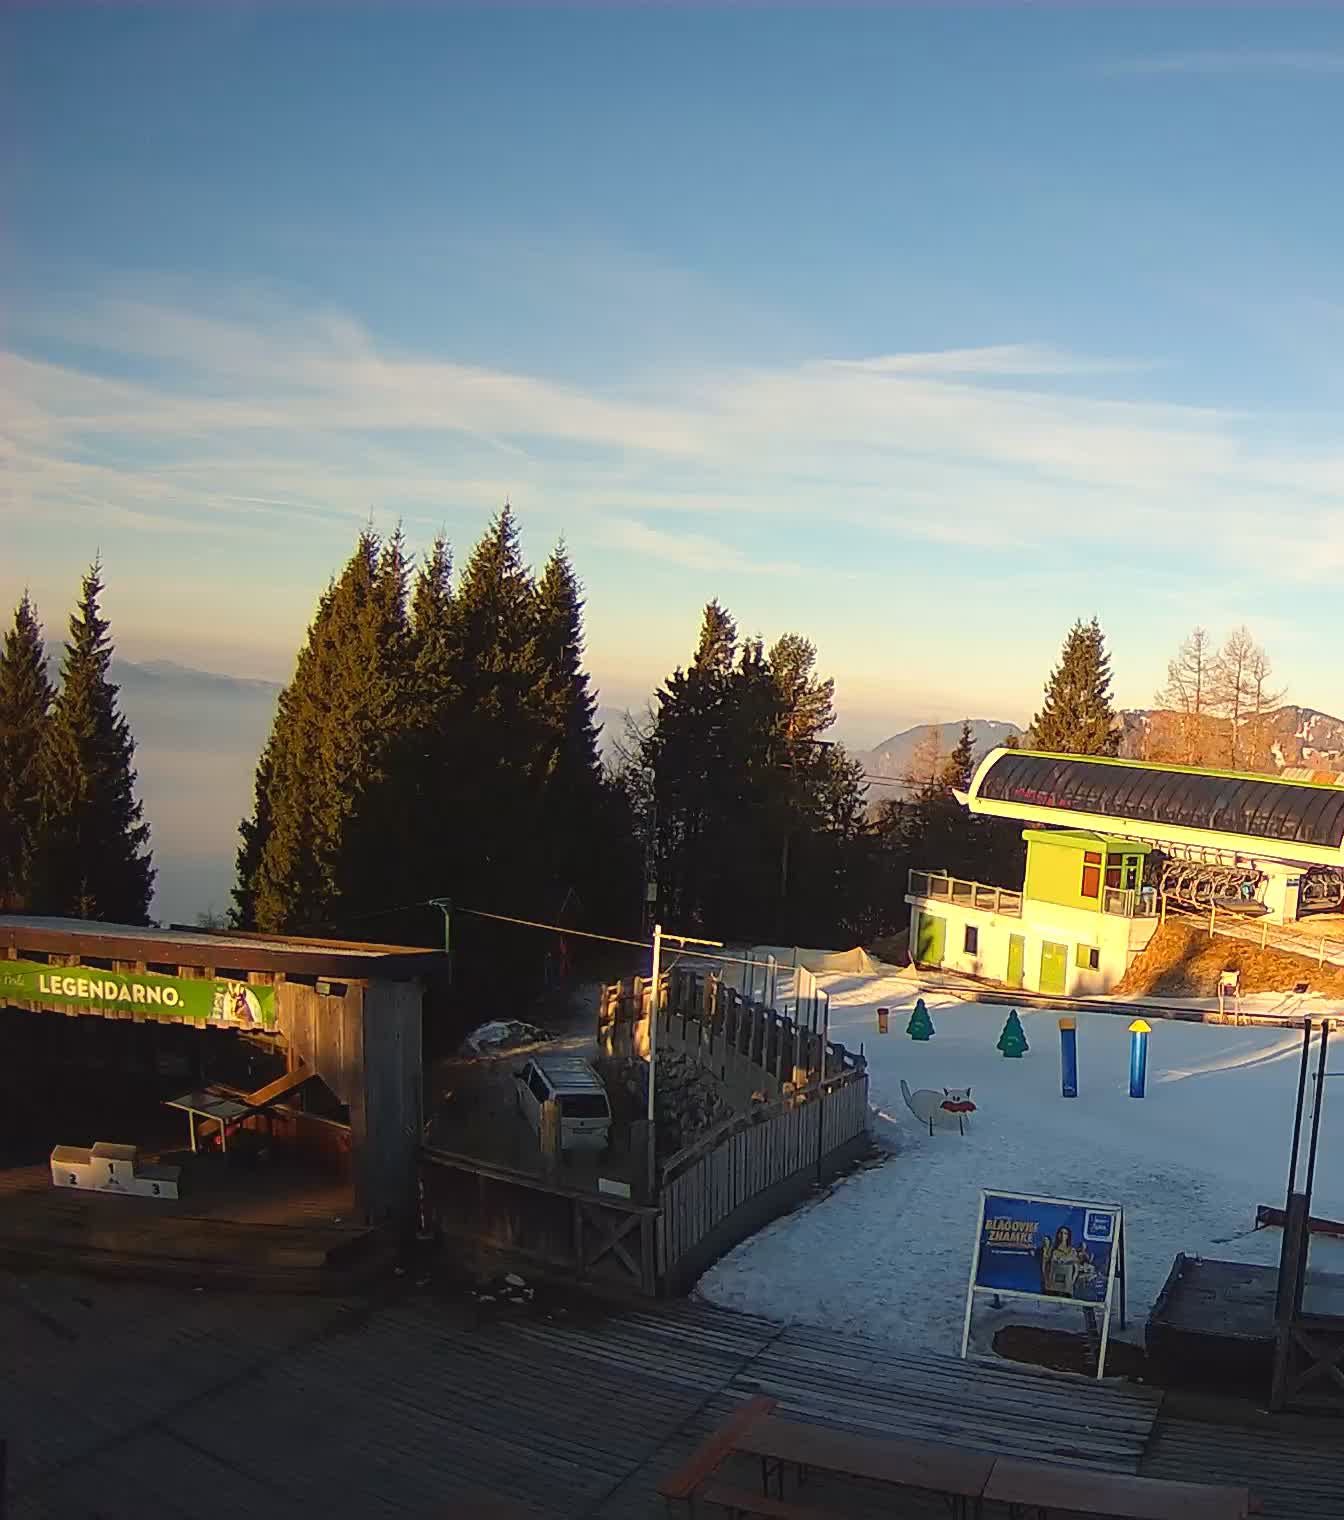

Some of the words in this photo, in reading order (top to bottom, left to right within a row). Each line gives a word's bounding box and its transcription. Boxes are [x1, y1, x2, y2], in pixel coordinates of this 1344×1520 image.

[39, 974, 185, 1008] LEGENDARNO.
[108, 1163, 114, 1174] 1
[69, 1174, 77, 1185] 2
[152, 1184, 160, 1195] 3
